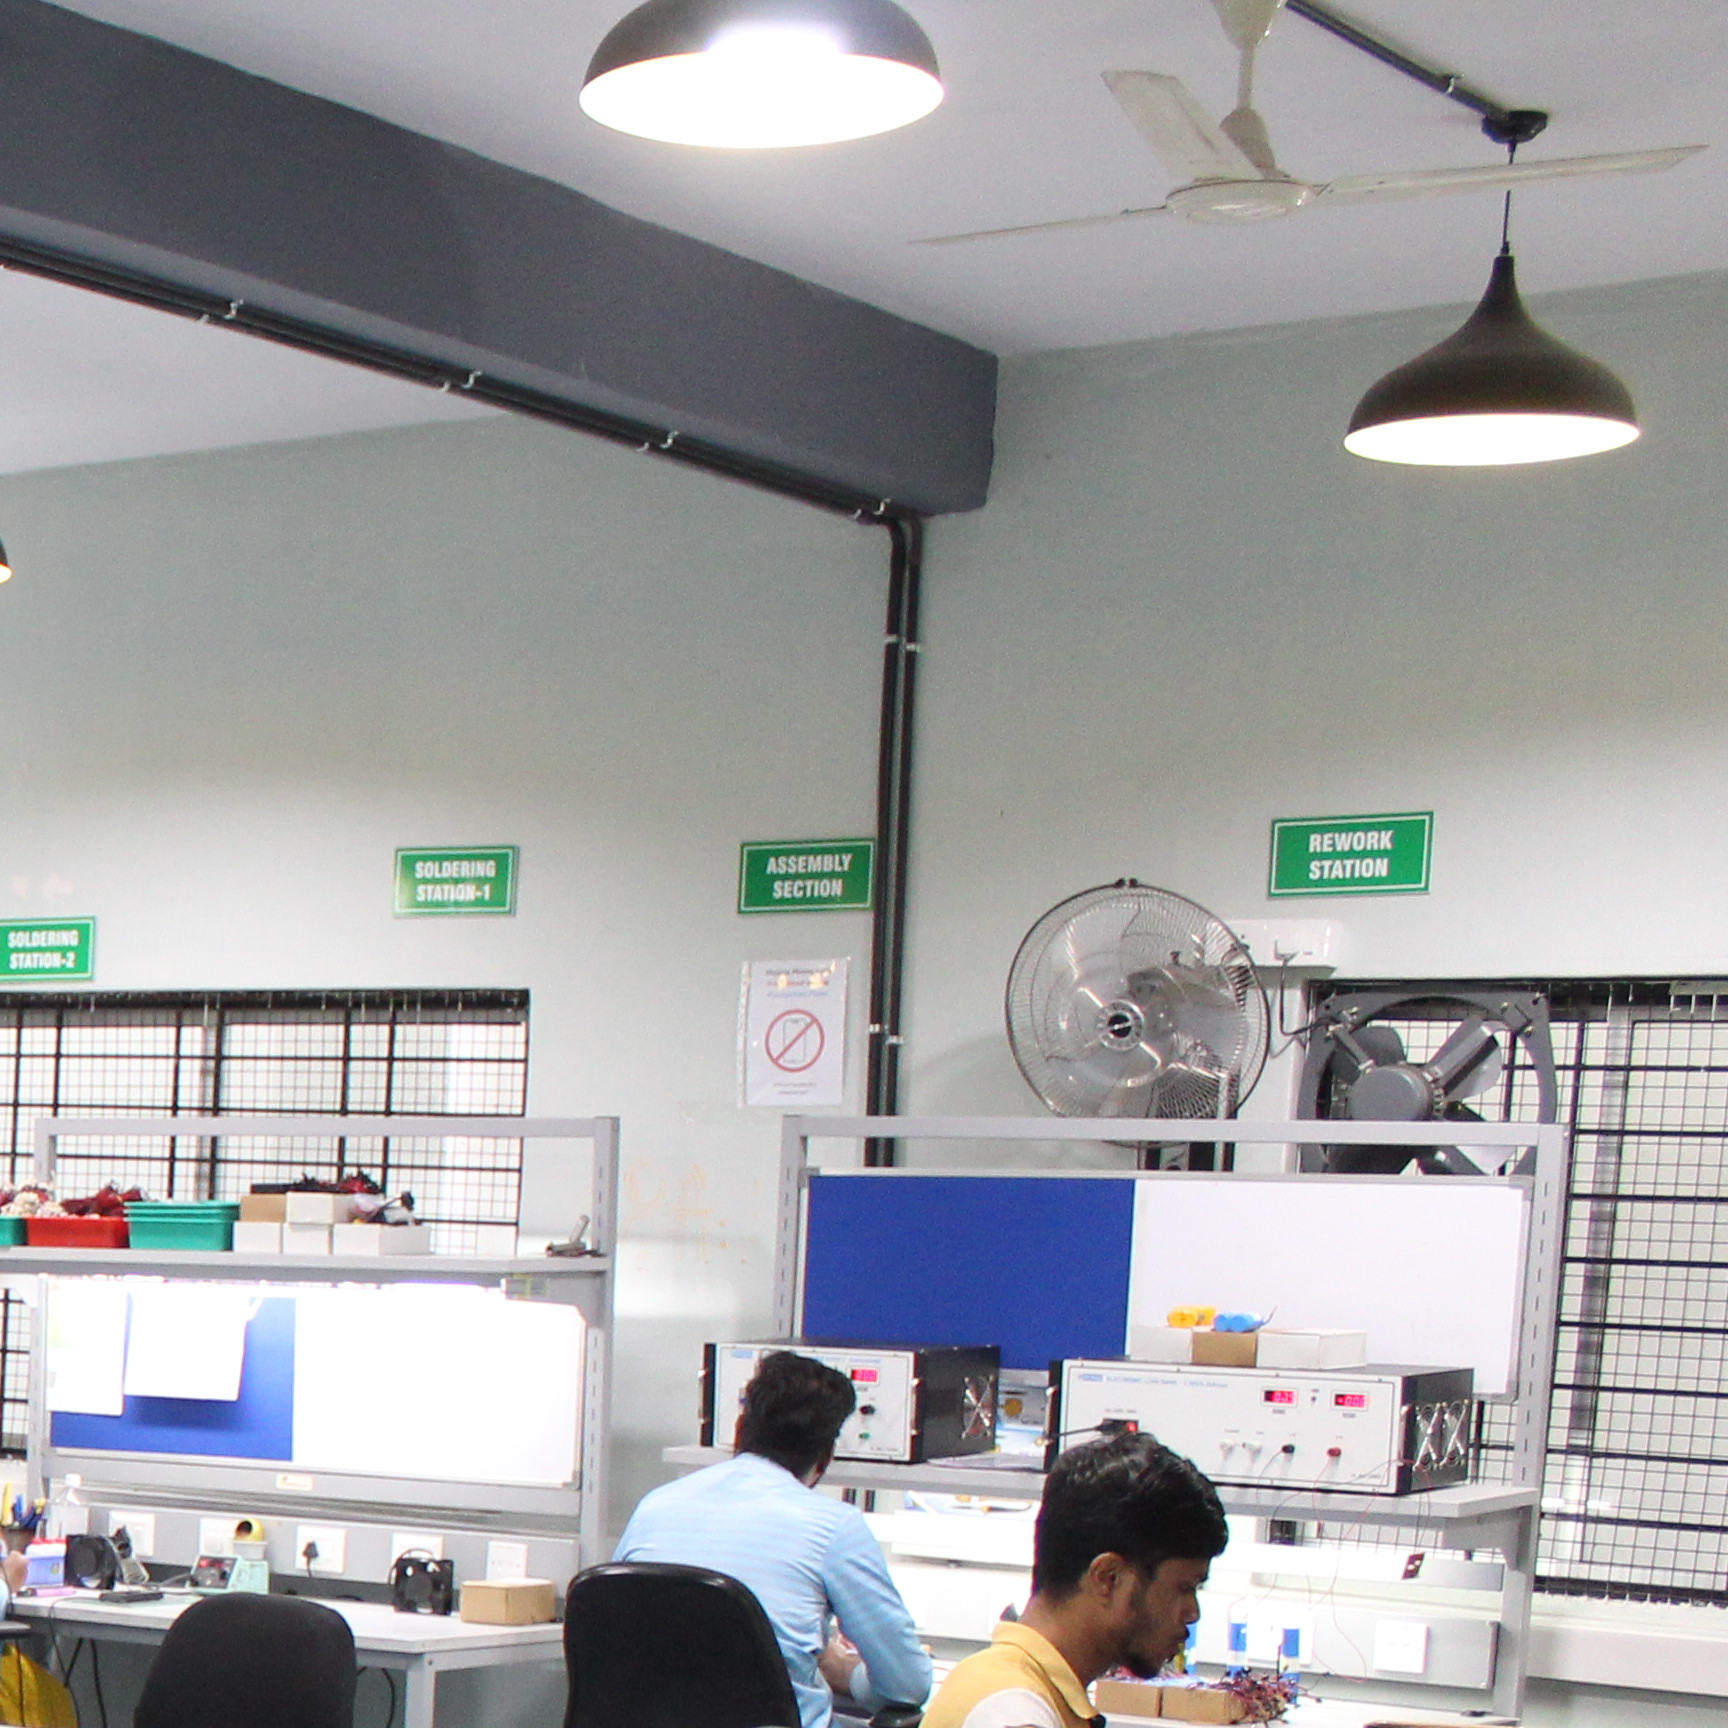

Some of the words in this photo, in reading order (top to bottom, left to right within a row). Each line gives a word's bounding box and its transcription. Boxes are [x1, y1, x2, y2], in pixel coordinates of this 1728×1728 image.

[1308, 829, 1394, 853] REWORK
[414, 860, 497, 879] SOLDERING
[766, 853, 852, 875] ASSEMBLY
[1308, 857, 1390, 880] STATION
[416, 883, 491, 902] STATION-1
[772, 878, 843, 899] SECTION
[7, 929, 79, 948] SOLDERING
[9, 950, 77, 970] STATION-2
